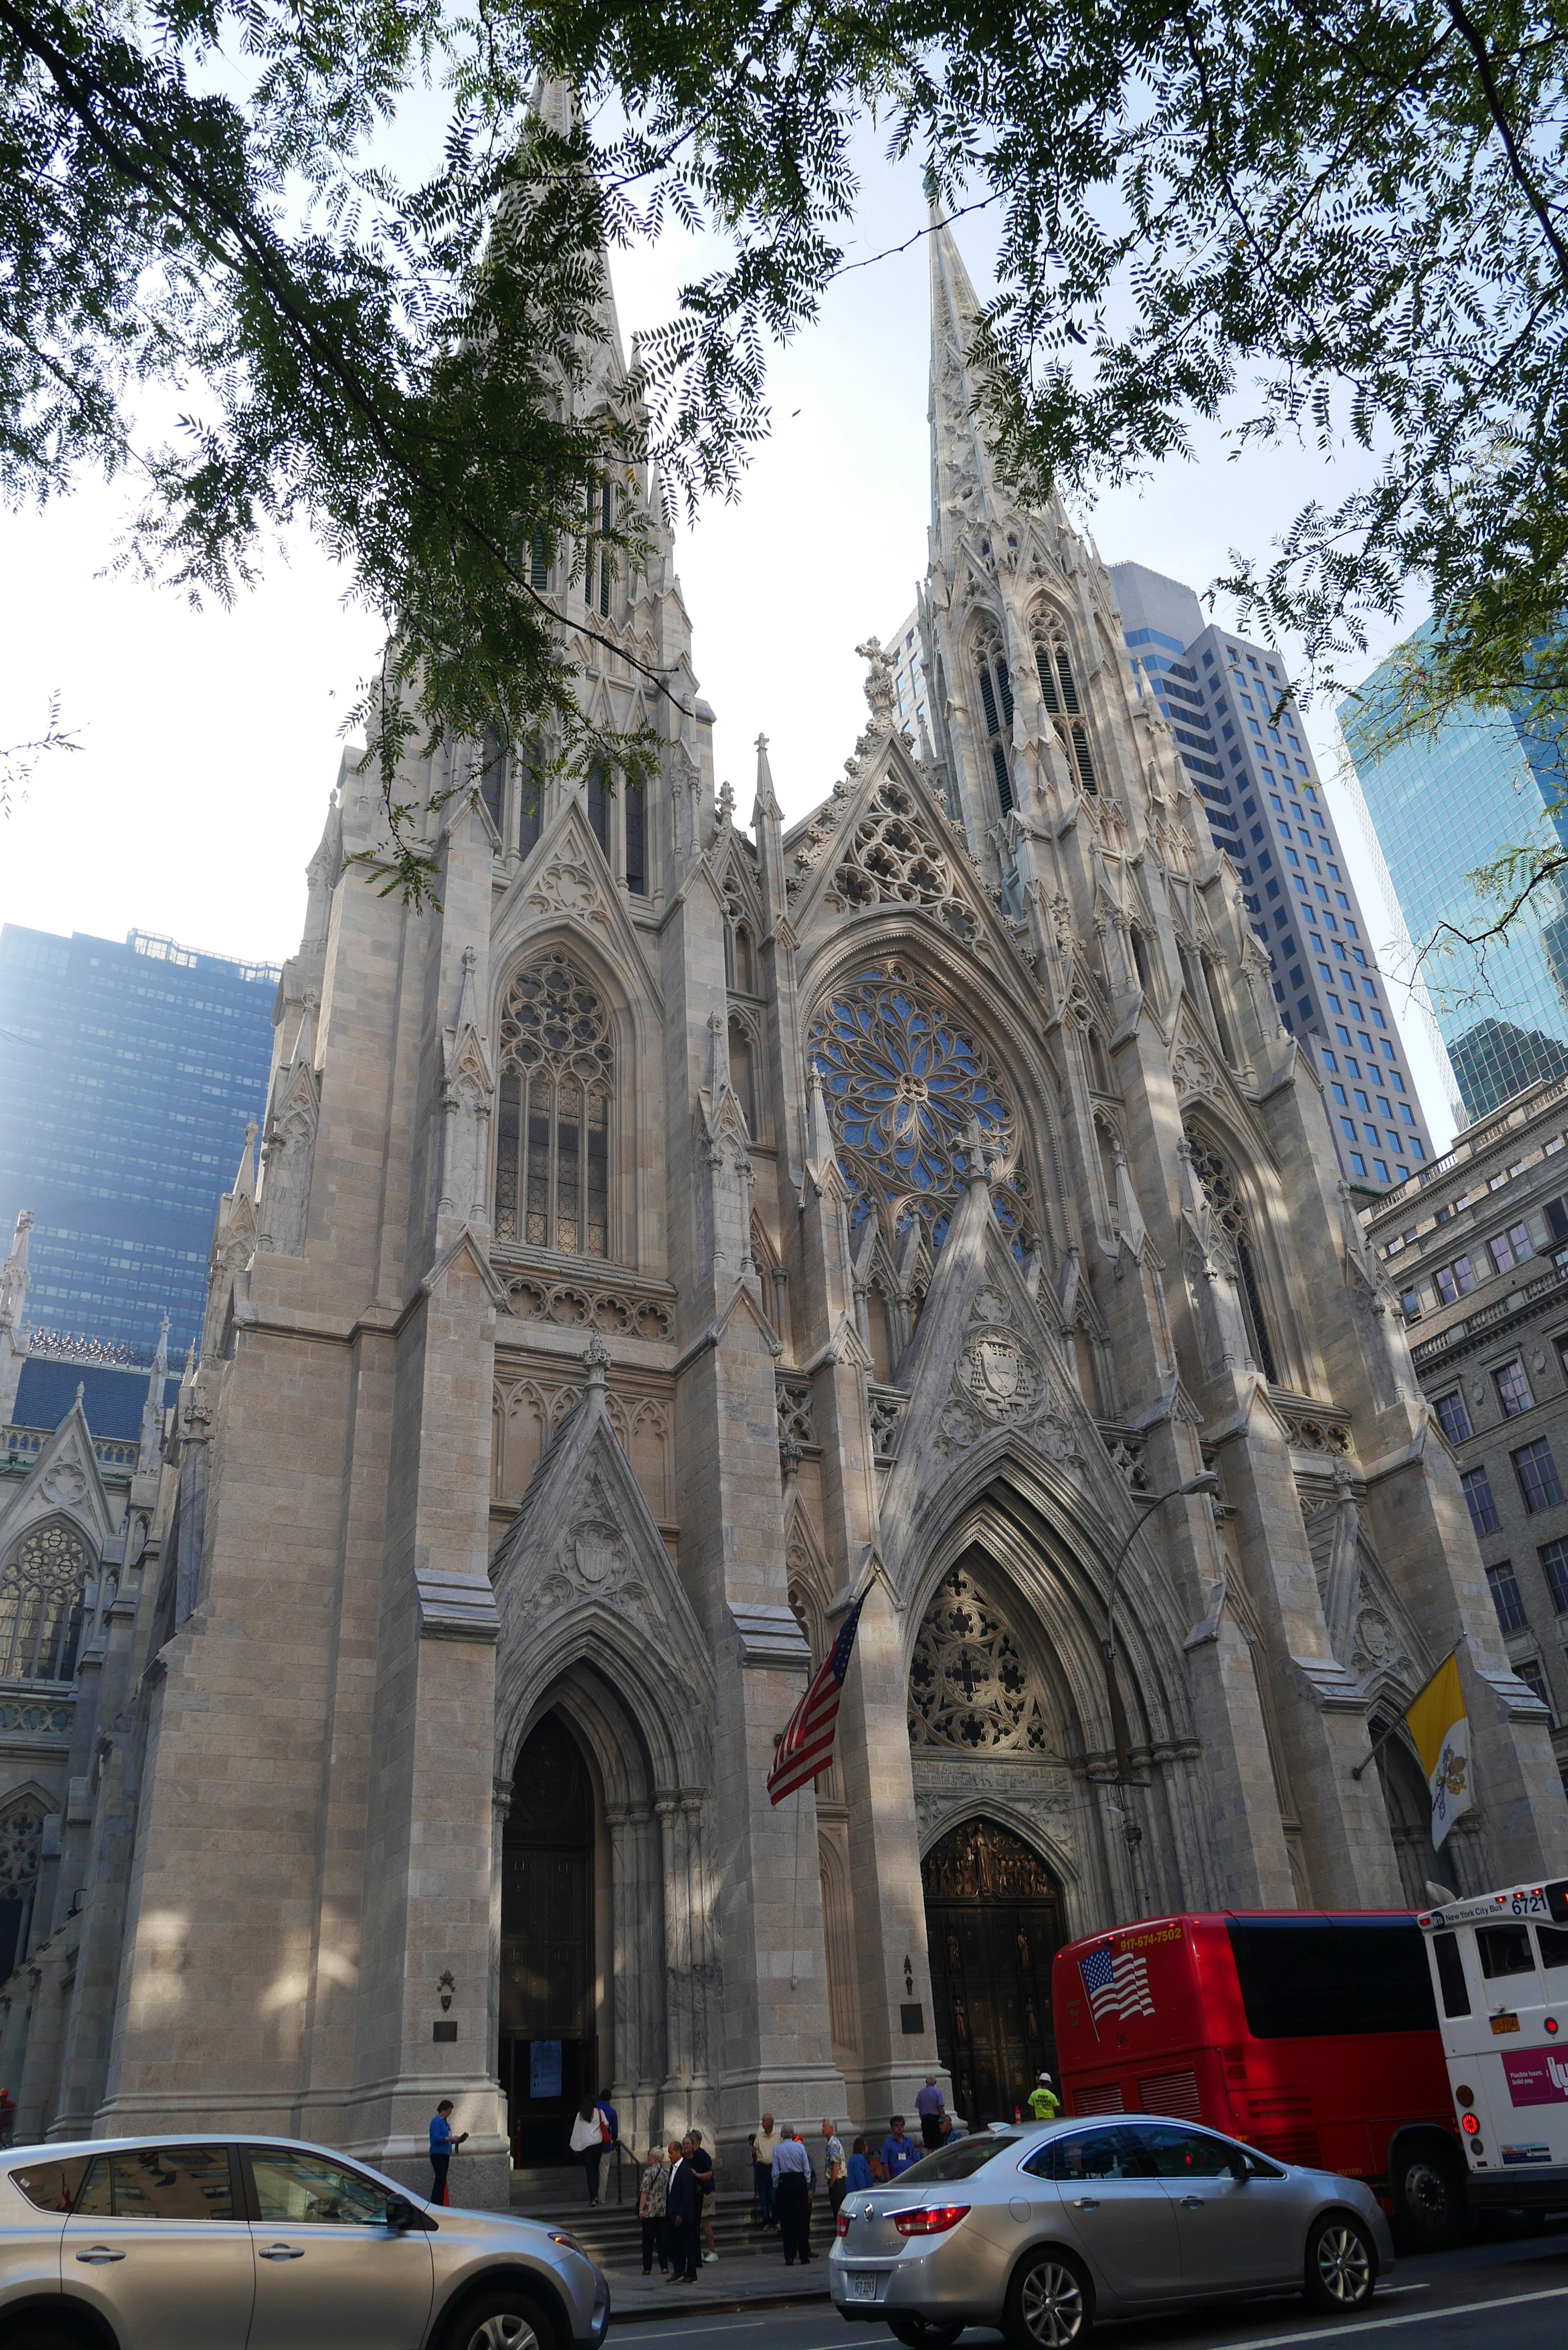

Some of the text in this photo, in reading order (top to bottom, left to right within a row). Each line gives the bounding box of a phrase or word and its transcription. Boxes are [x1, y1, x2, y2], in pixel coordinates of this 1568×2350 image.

[1512, 1895, 1546, 1915] 6721
[1432, 1916, 1444, 1927] MTA
[1460, 1910, 1474, 1918] York
[1120, 1927, 1181, 1951] 917-674-7502
[1337, 2167, 1363, 2176] BATTERY
